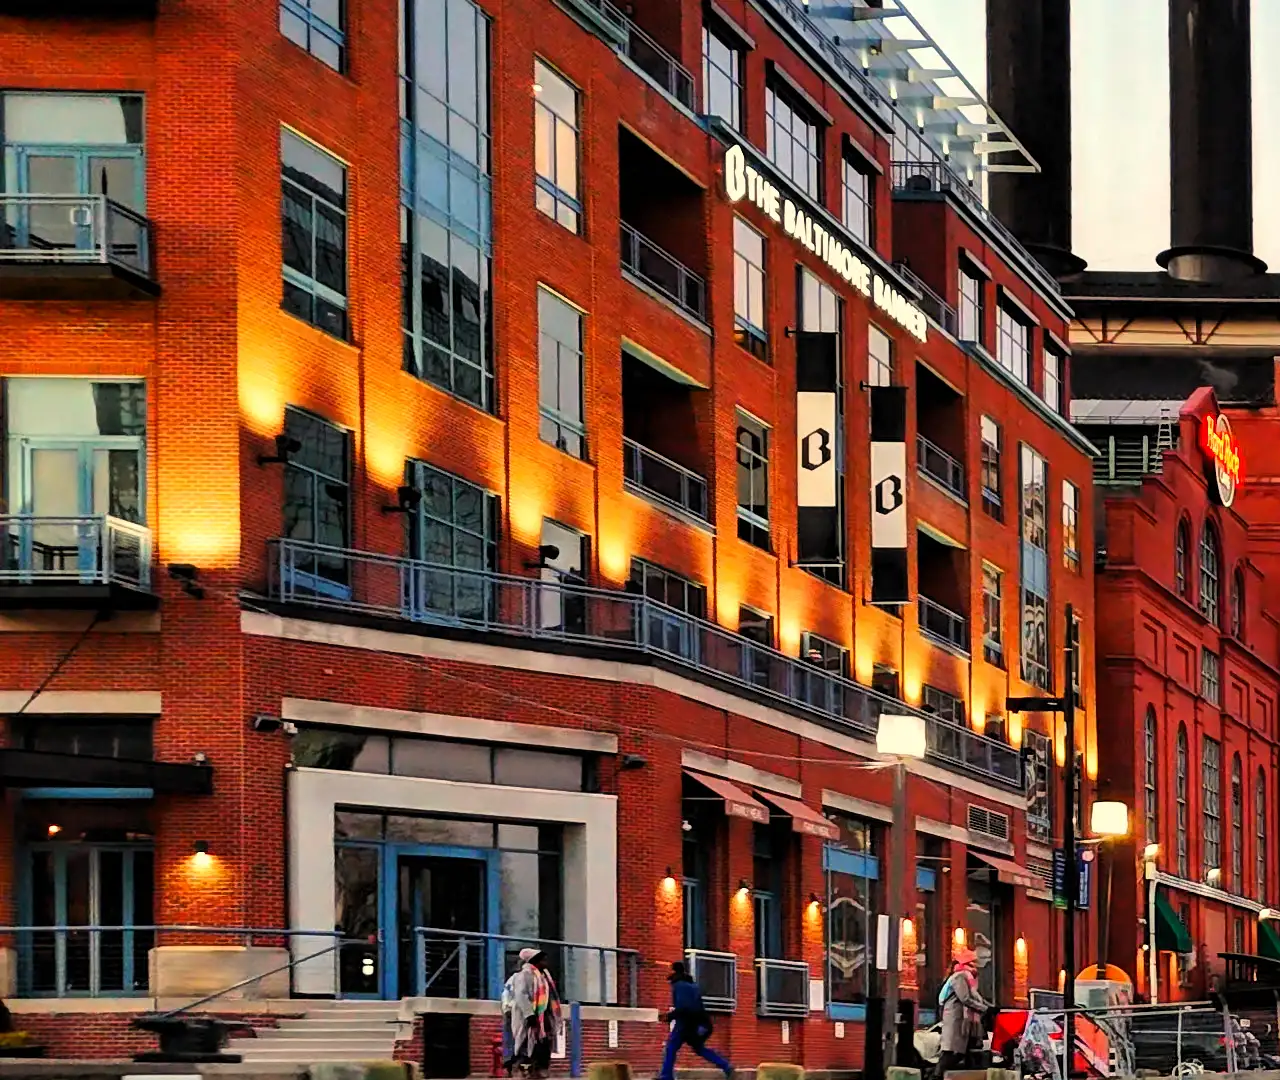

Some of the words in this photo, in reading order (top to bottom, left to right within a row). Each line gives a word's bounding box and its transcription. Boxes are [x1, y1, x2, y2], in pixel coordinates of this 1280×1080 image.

[746, 165, 780, 222] THE
[784, 199, 871, 297] BALTIMORE
[873, 274, 928, 343] BANNER
[802, 427, 831, 471] B
[875, 474, 903, 515] B
